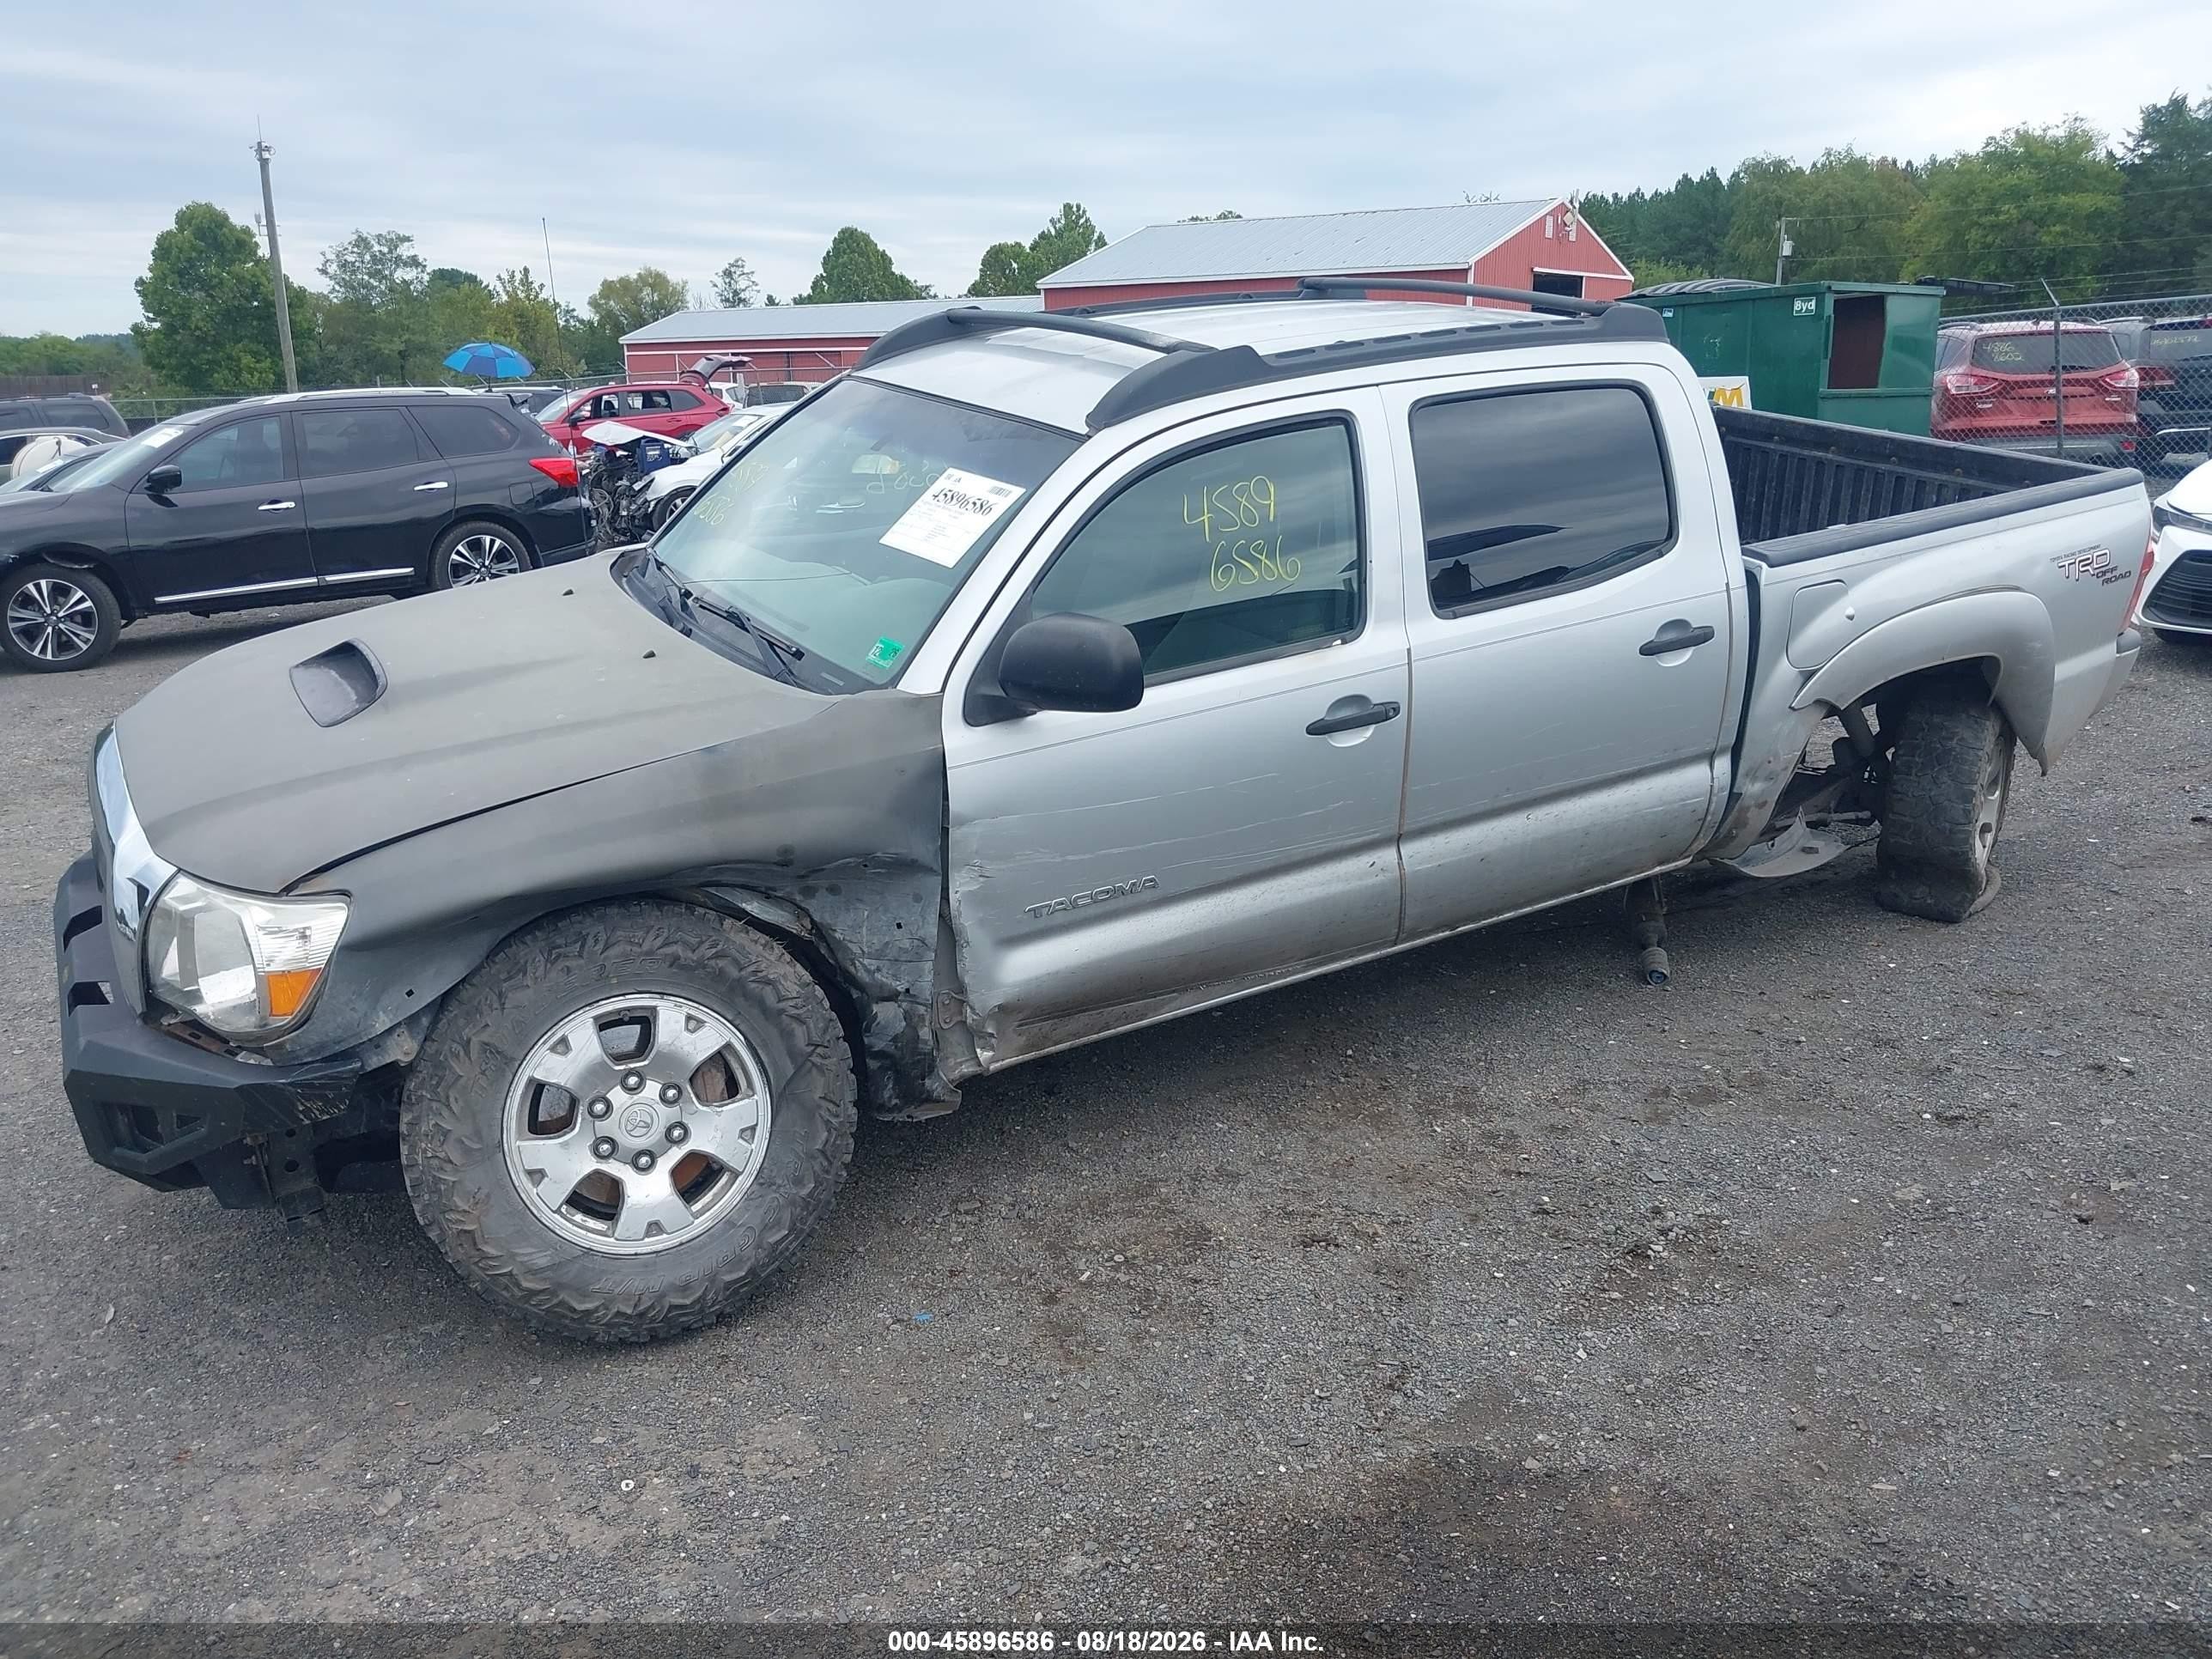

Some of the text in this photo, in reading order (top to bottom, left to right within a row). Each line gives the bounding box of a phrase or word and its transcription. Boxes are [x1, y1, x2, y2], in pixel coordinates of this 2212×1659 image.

[932, 488, 999, 516] 45896586
[1183, 475, 1275, 543] 4589
[1211, 535, 1301, 592] 6586
[2057, 549, 2110, 583] TRD
[2096, 565, 2118, 580] OFF
[2101, 570, 2132, 586] ROAD
[1024, 875, 1160, 919] TACOMA
[679, 1224, 757, 1287] GRIP
[590, 1273, 666, 1297] M/T
